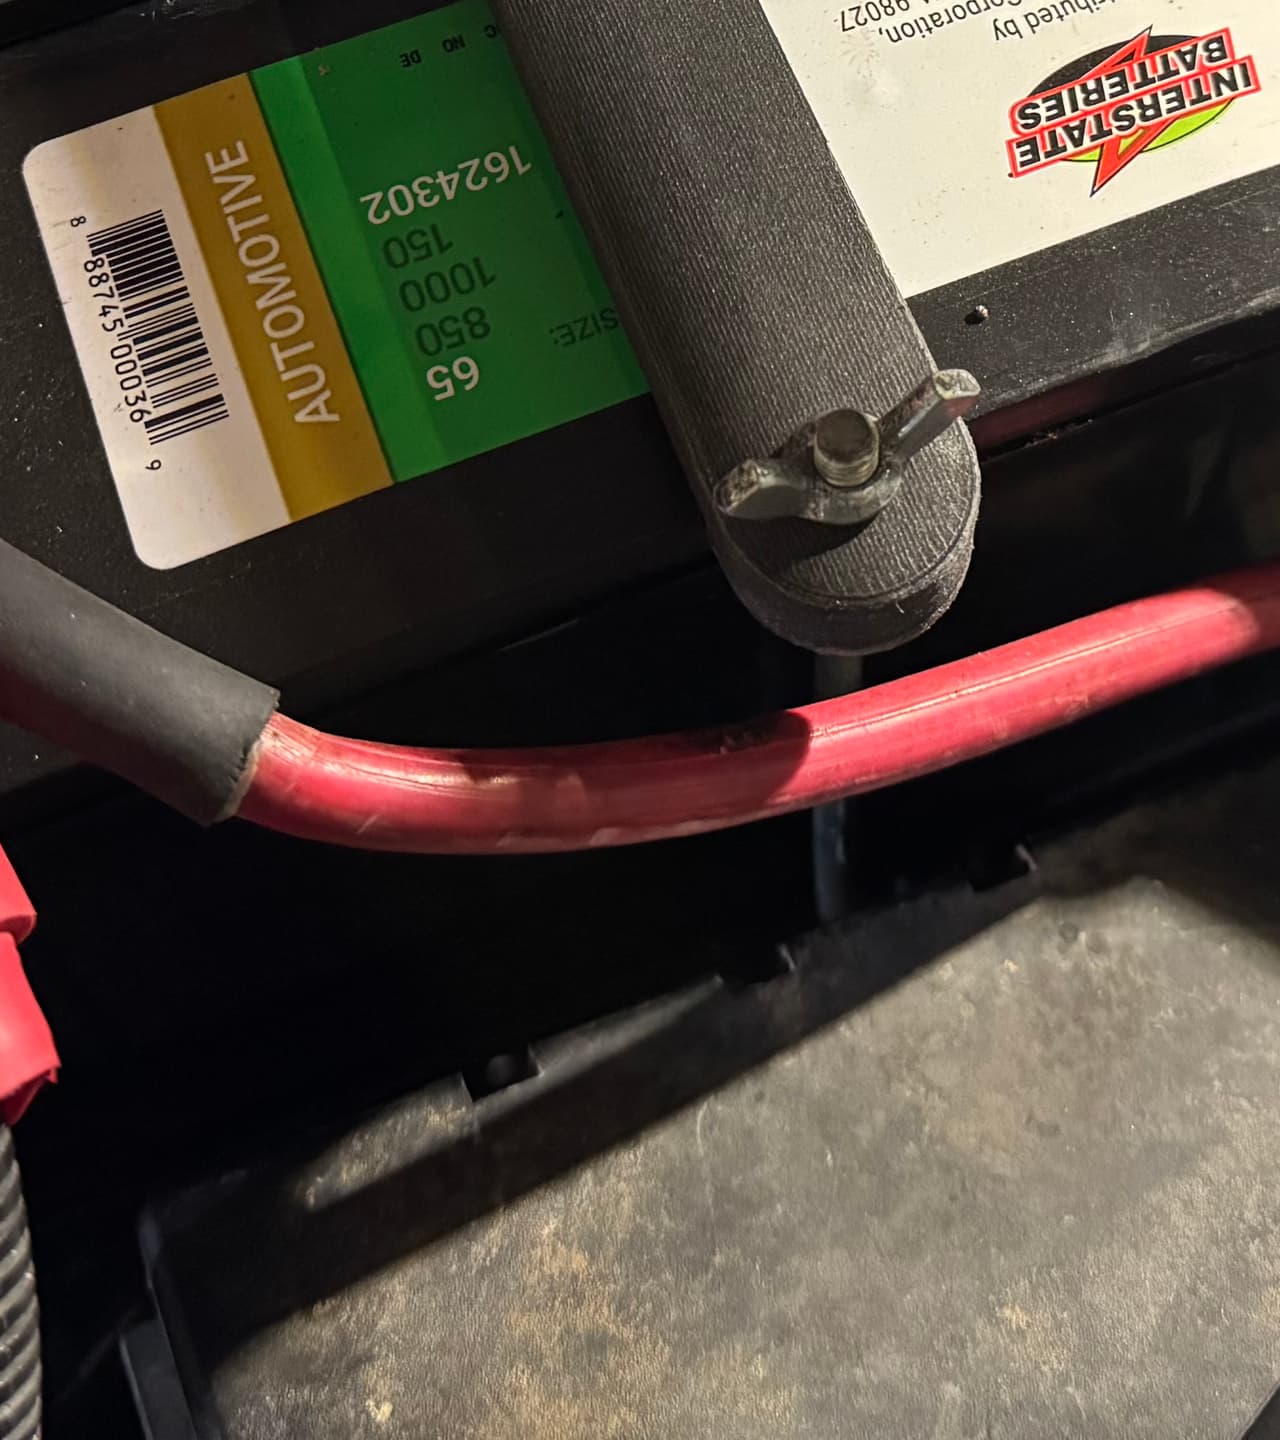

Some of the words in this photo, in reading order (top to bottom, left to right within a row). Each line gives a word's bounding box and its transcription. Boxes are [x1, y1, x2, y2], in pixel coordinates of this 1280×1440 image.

[441, 34, 466, 53] NO
[989, 13, 1022, 46] by
[400, 49, 422, 68] DE
[1013, 34, 1229, 131] BATTERIES
[1011, 61, 1253, 168] INTERSTATE
[360, 145, 532, 226] 1624302
[382, 223, 454, 269] 150
[205, 141, 340, 422] AUTOMOTIVE
[399, 257, 496, 312] 1000
[70, 216, 87, 228] 8
[84, 257, 124, 333] 88745
[110, 344, 152, 423] 00036
[415, 307, 491, 357] 850
[426, 356, 480, 401] 65
